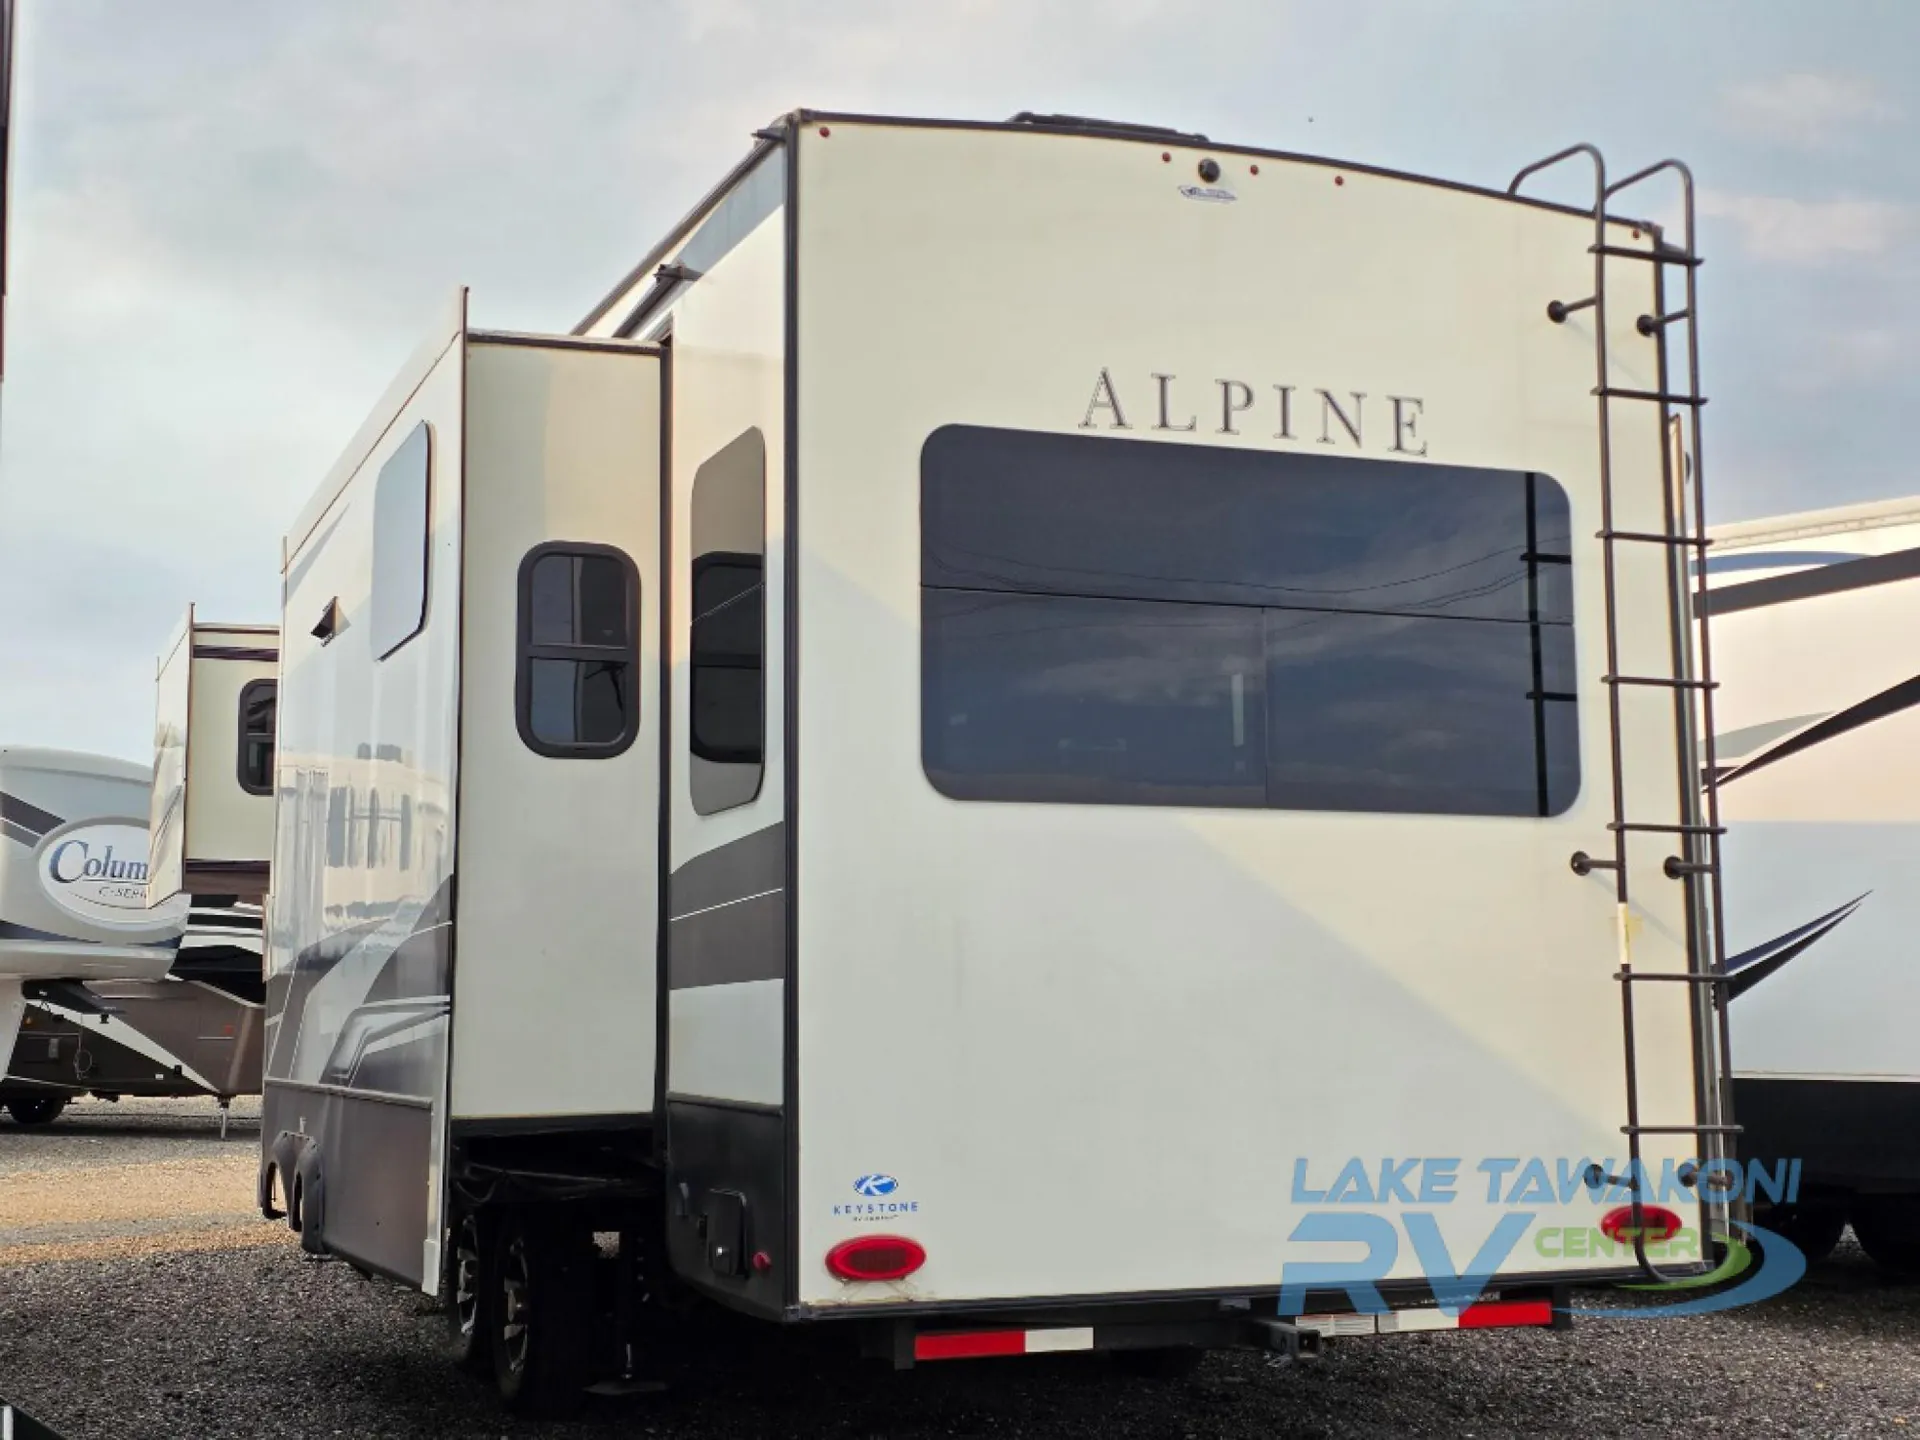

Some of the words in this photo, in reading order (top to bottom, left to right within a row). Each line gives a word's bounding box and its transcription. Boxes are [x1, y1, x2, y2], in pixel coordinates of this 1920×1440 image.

[1078, 366, 1428, 458] ALPINE
[48, 839, 149, 884] Colum
[833, 1202, 919, 1216] KEYSTONE
